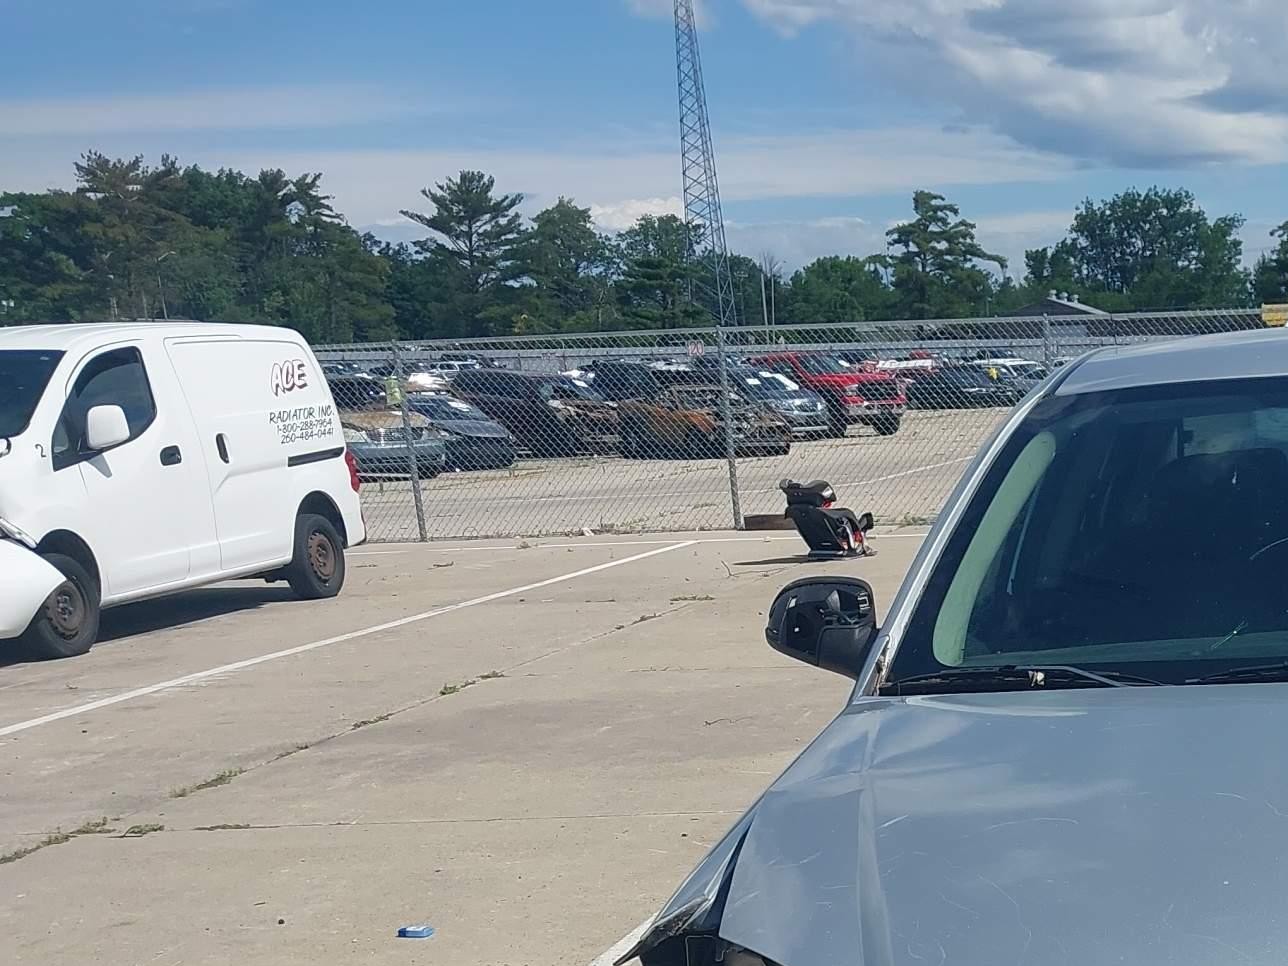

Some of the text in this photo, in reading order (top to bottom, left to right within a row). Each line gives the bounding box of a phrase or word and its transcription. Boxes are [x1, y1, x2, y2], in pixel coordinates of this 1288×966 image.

[271, 359, 308, 396] ACE
[269, 405, 335, 424] RADIATOR INC.
